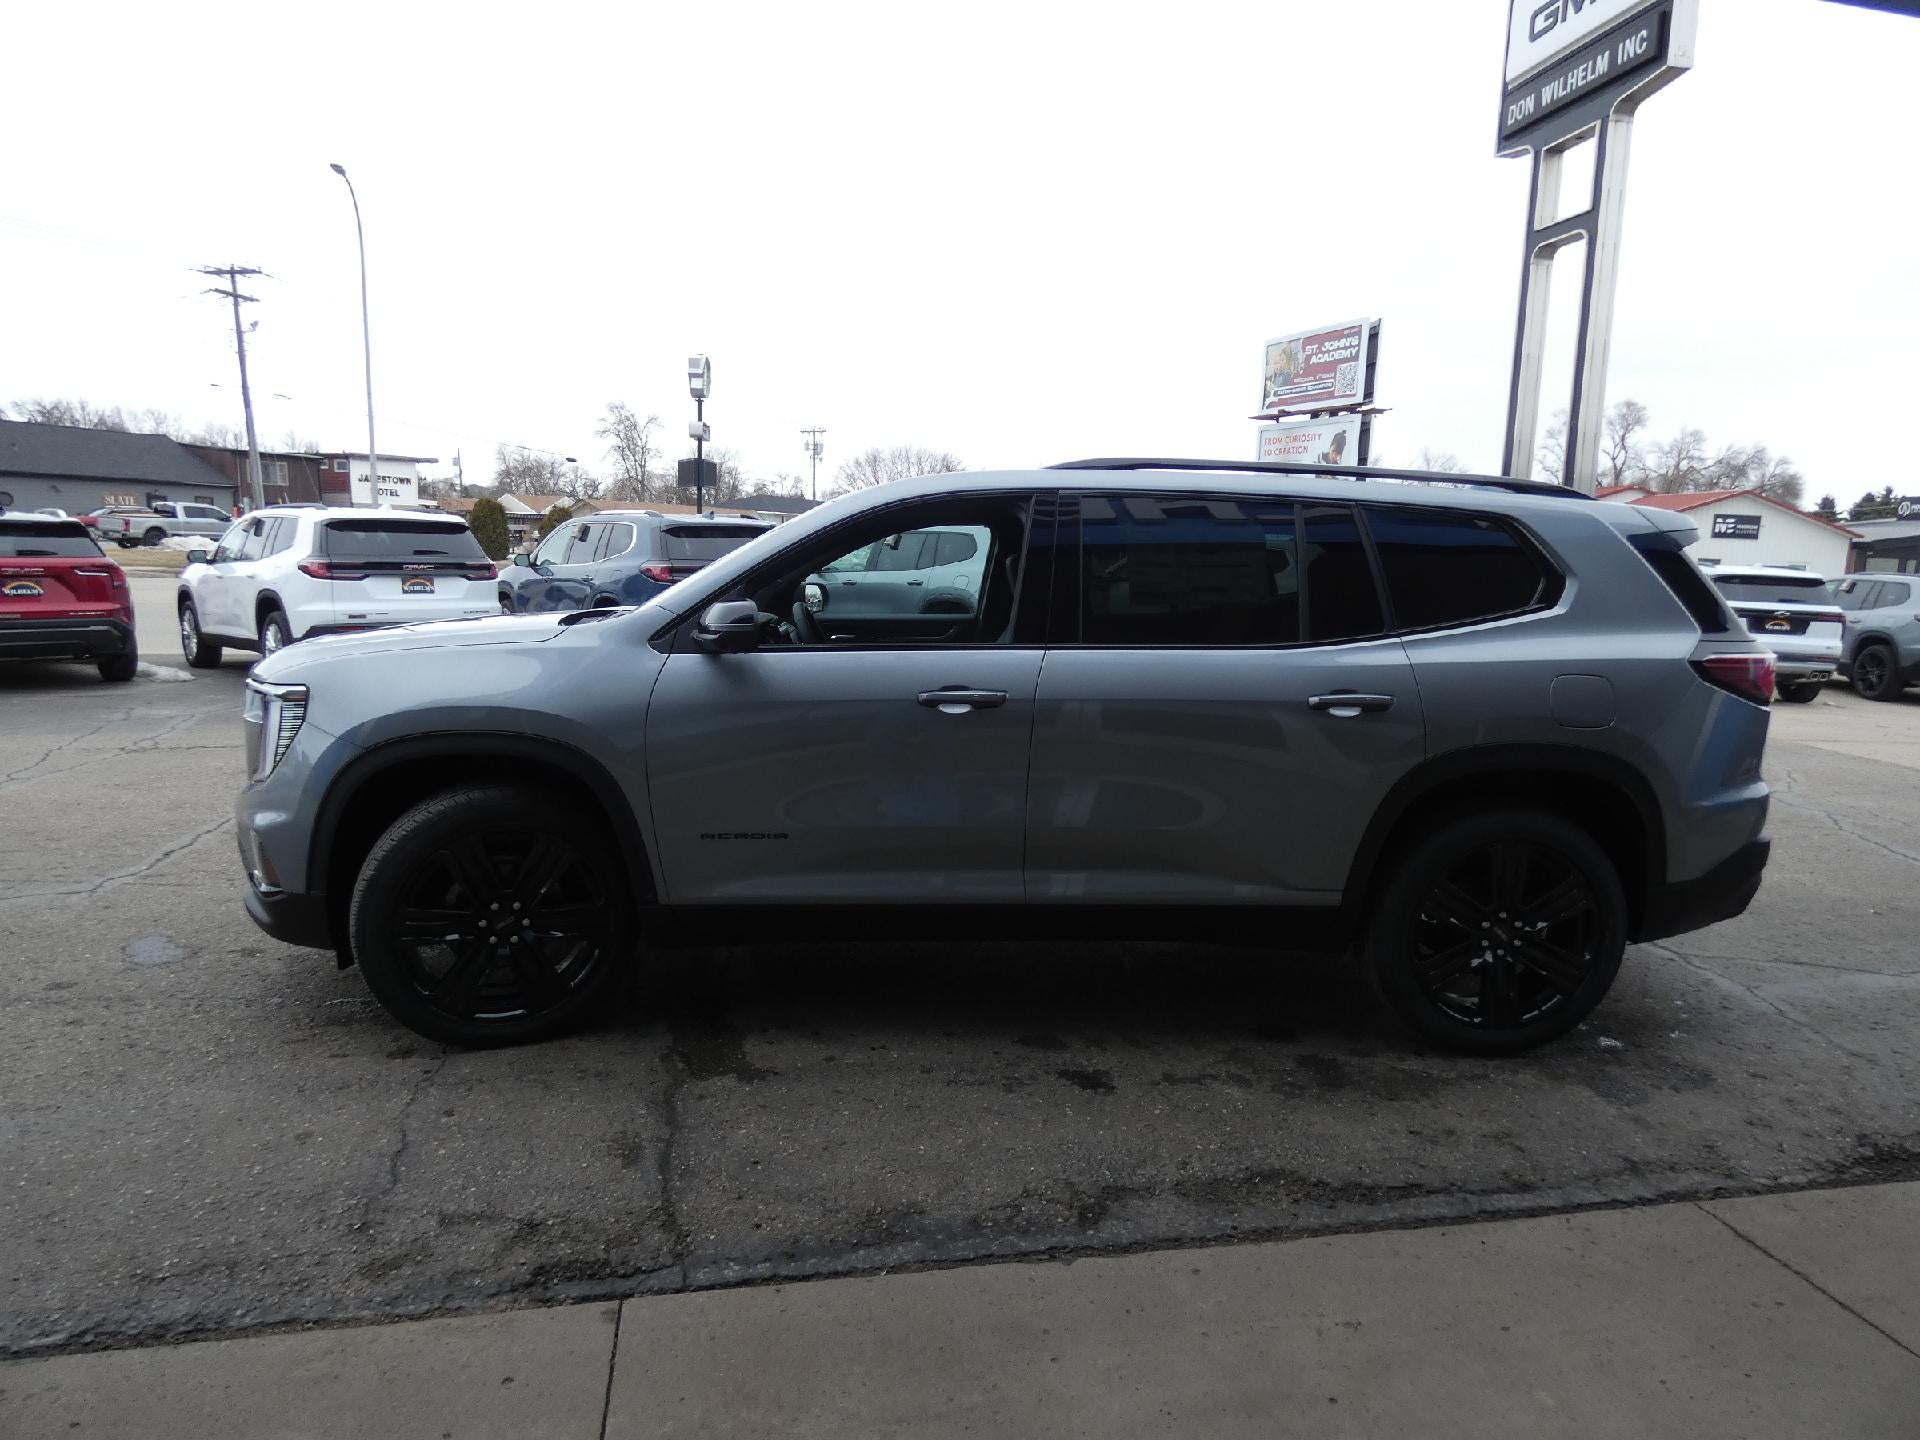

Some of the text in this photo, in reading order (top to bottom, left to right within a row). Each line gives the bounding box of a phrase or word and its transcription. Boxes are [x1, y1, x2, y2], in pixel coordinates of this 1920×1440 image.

[1507, 29, 1648, 125] DON WILHELM INC
[1322, 335, 1359, 352] JOHN'S
[1310, 346, 1359, 365] ACADEMY
[1264, 433, 1322, 446] FROM CURIOSITY
[1264, 445, 1309, 456] TO CREATION
[358, 473, 412, 486] JAESTOWN
[376, 488, 400, 497] OTEL
[104, 495, 137, 506] SLATE
[700, 832, 789, 840] ACADIA
